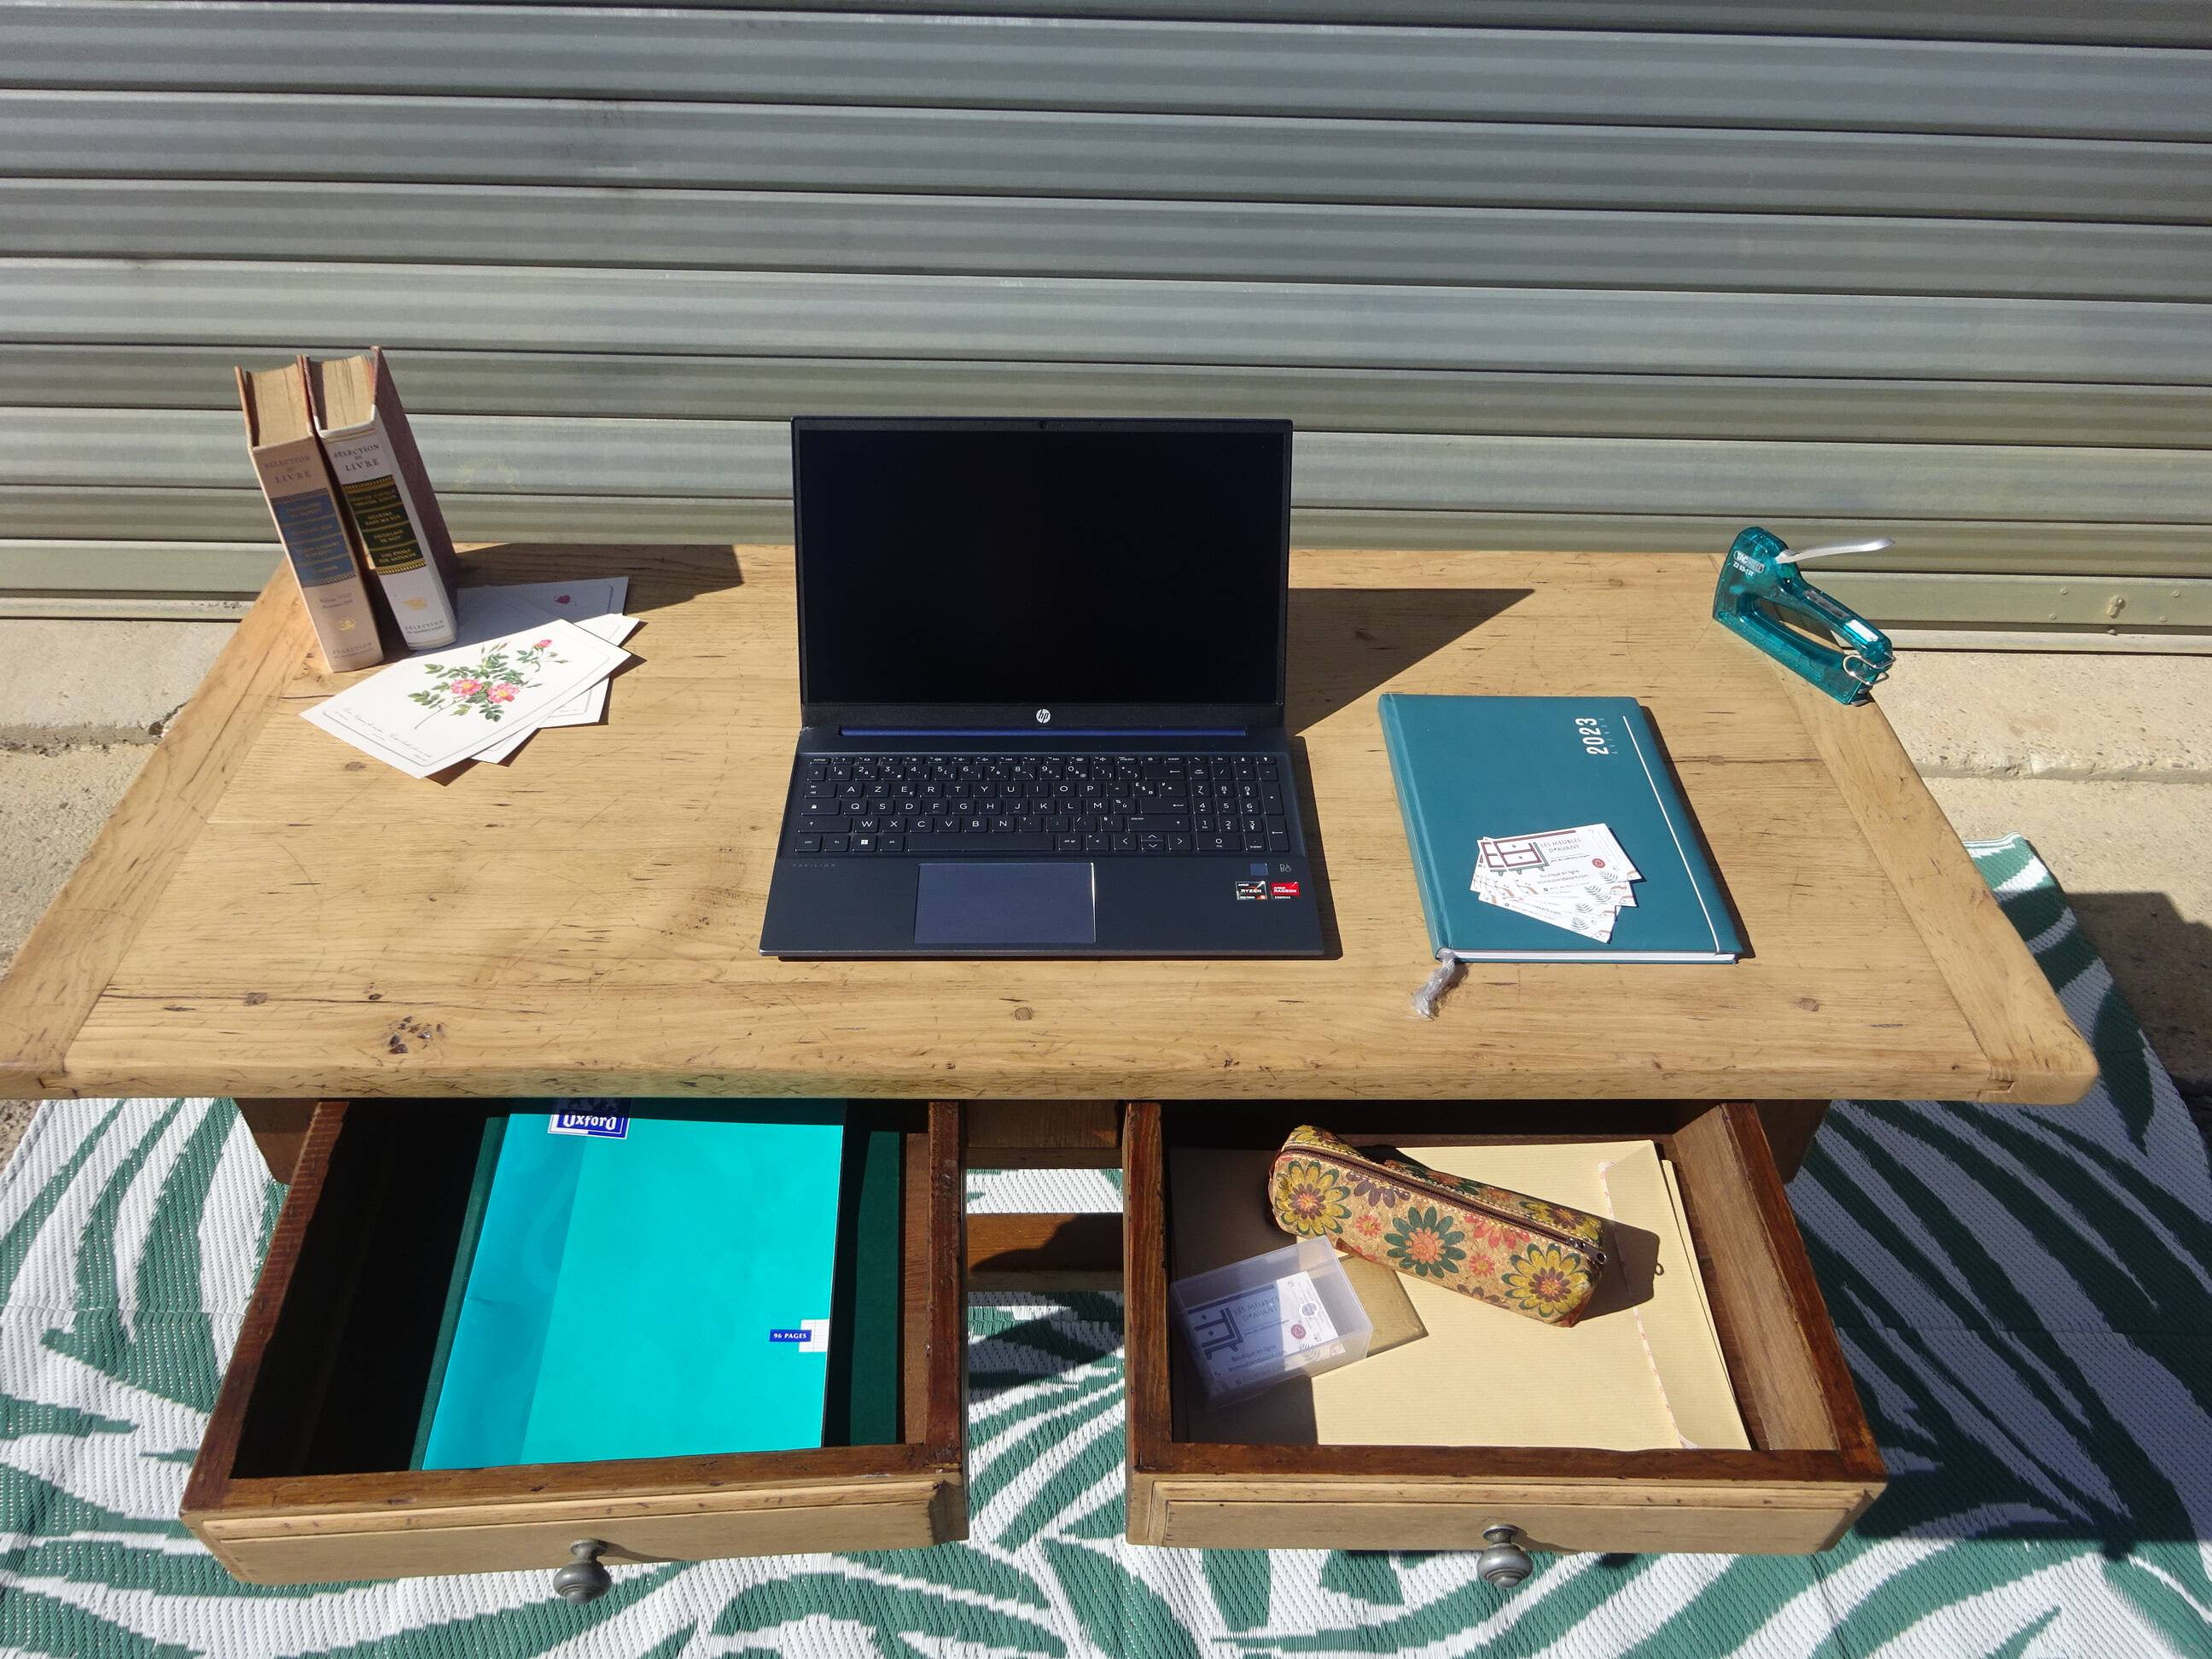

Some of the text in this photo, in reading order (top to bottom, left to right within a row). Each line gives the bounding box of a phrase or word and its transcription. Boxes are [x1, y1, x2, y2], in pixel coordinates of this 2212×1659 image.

[345, 458, 381, 472] LIVRE
[1037, 709, 1050, 723] hp
[1575, 718, 1610, 754] 2023
[1552, 837, 1581, 847] MEUBLES
[562, 1113, 618, 1132] Oxford
